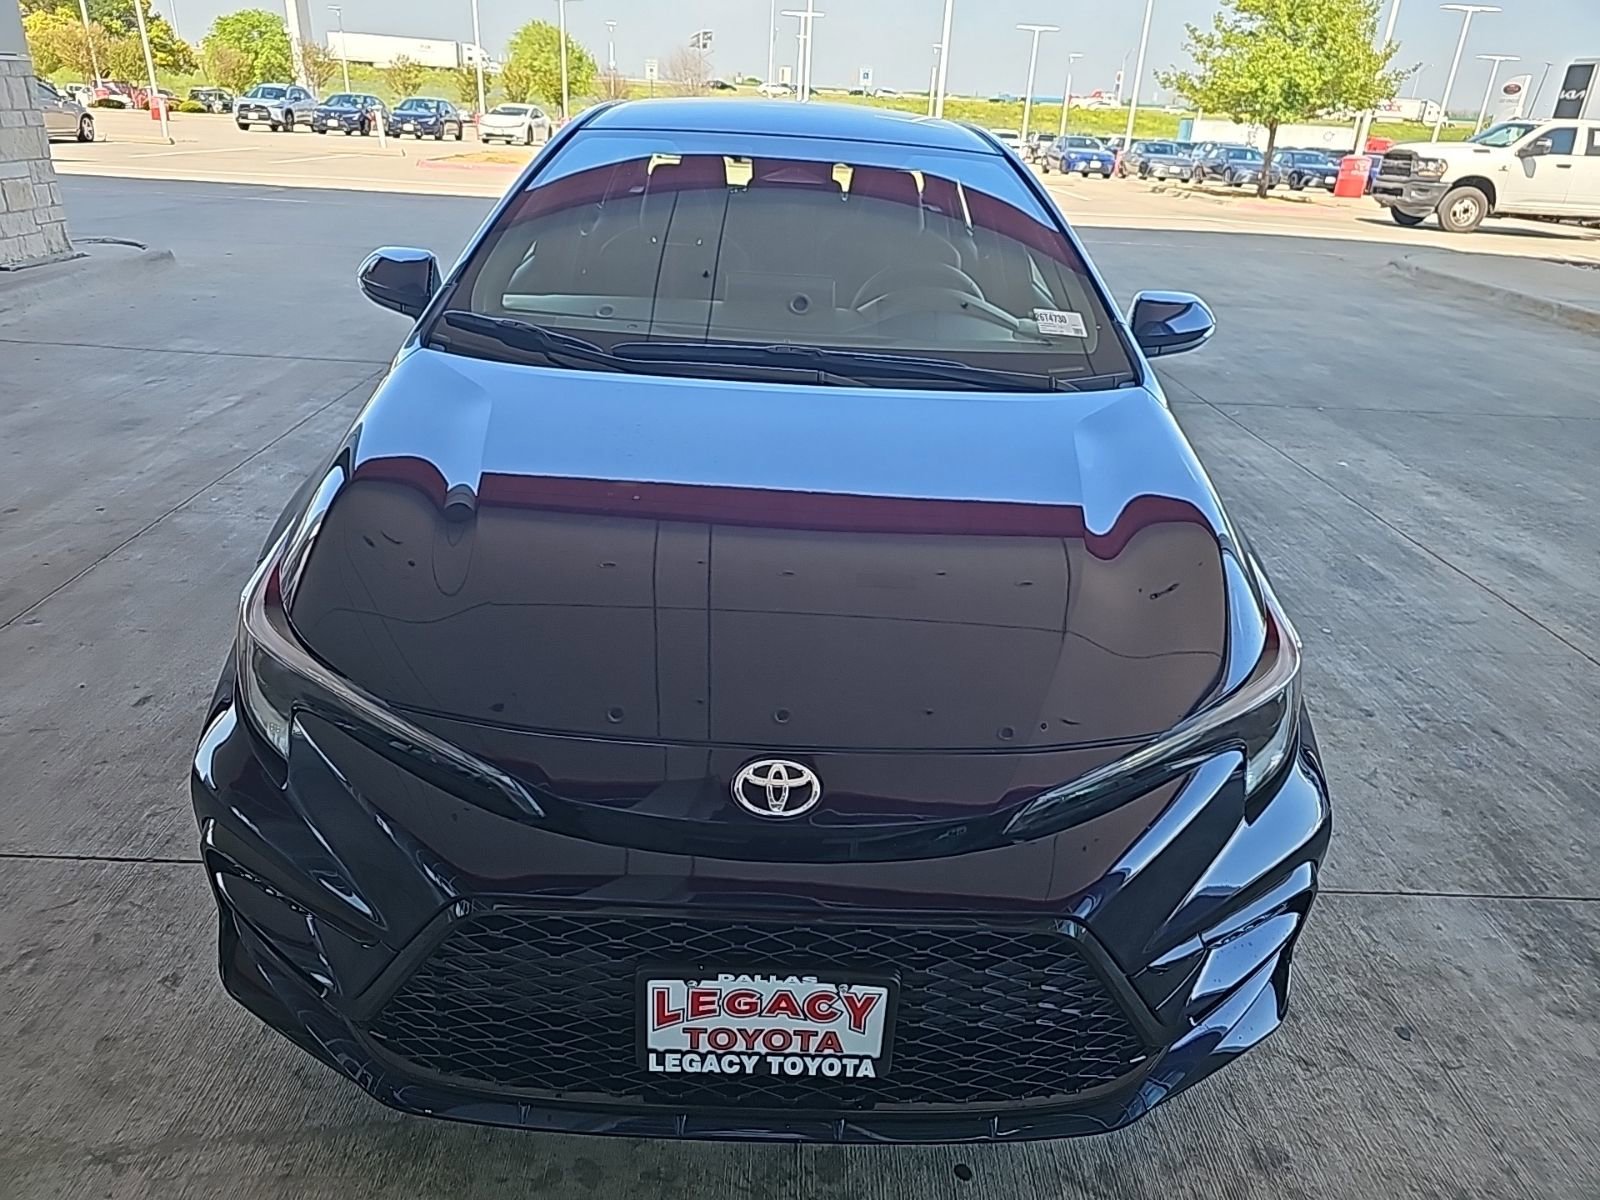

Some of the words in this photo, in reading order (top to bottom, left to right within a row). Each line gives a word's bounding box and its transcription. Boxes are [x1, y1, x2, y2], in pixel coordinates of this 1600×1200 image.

[717, 973, 819, 984] DALLAS
[652, 986, 882, 1035] LEGACY
[682, 1027, 844, 1053] TOYOTA
[648, 1053, 760, 1074] LEGACY
[767, 1055, 876, 1078] TOYOTA
